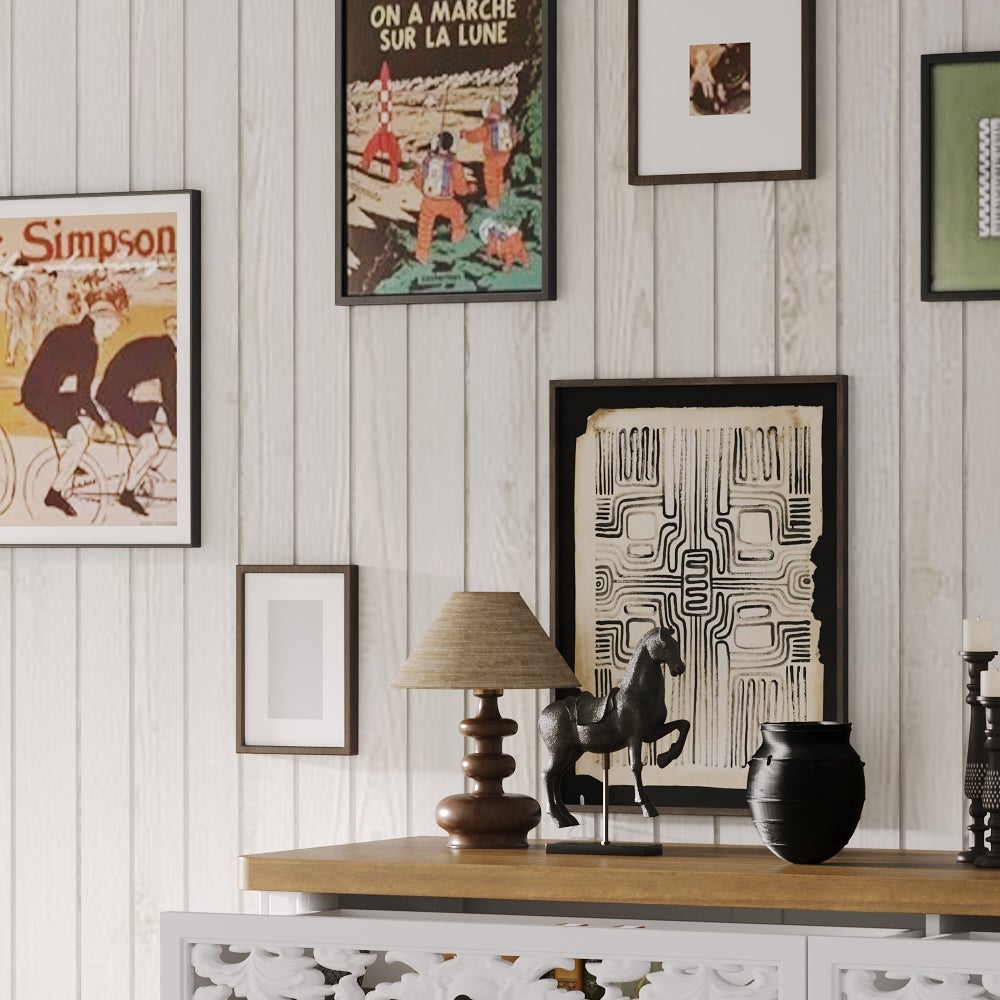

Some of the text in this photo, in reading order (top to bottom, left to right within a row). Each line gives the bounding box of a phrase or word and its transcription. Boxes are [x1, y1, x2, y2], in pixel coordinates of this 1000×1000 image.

[370, 4, 401, 28] ON
[407, 2, 424, 25] A
[380, 21, 507, 51] SUR LA LUNE
[21, 218, 177, 264] Simpson
